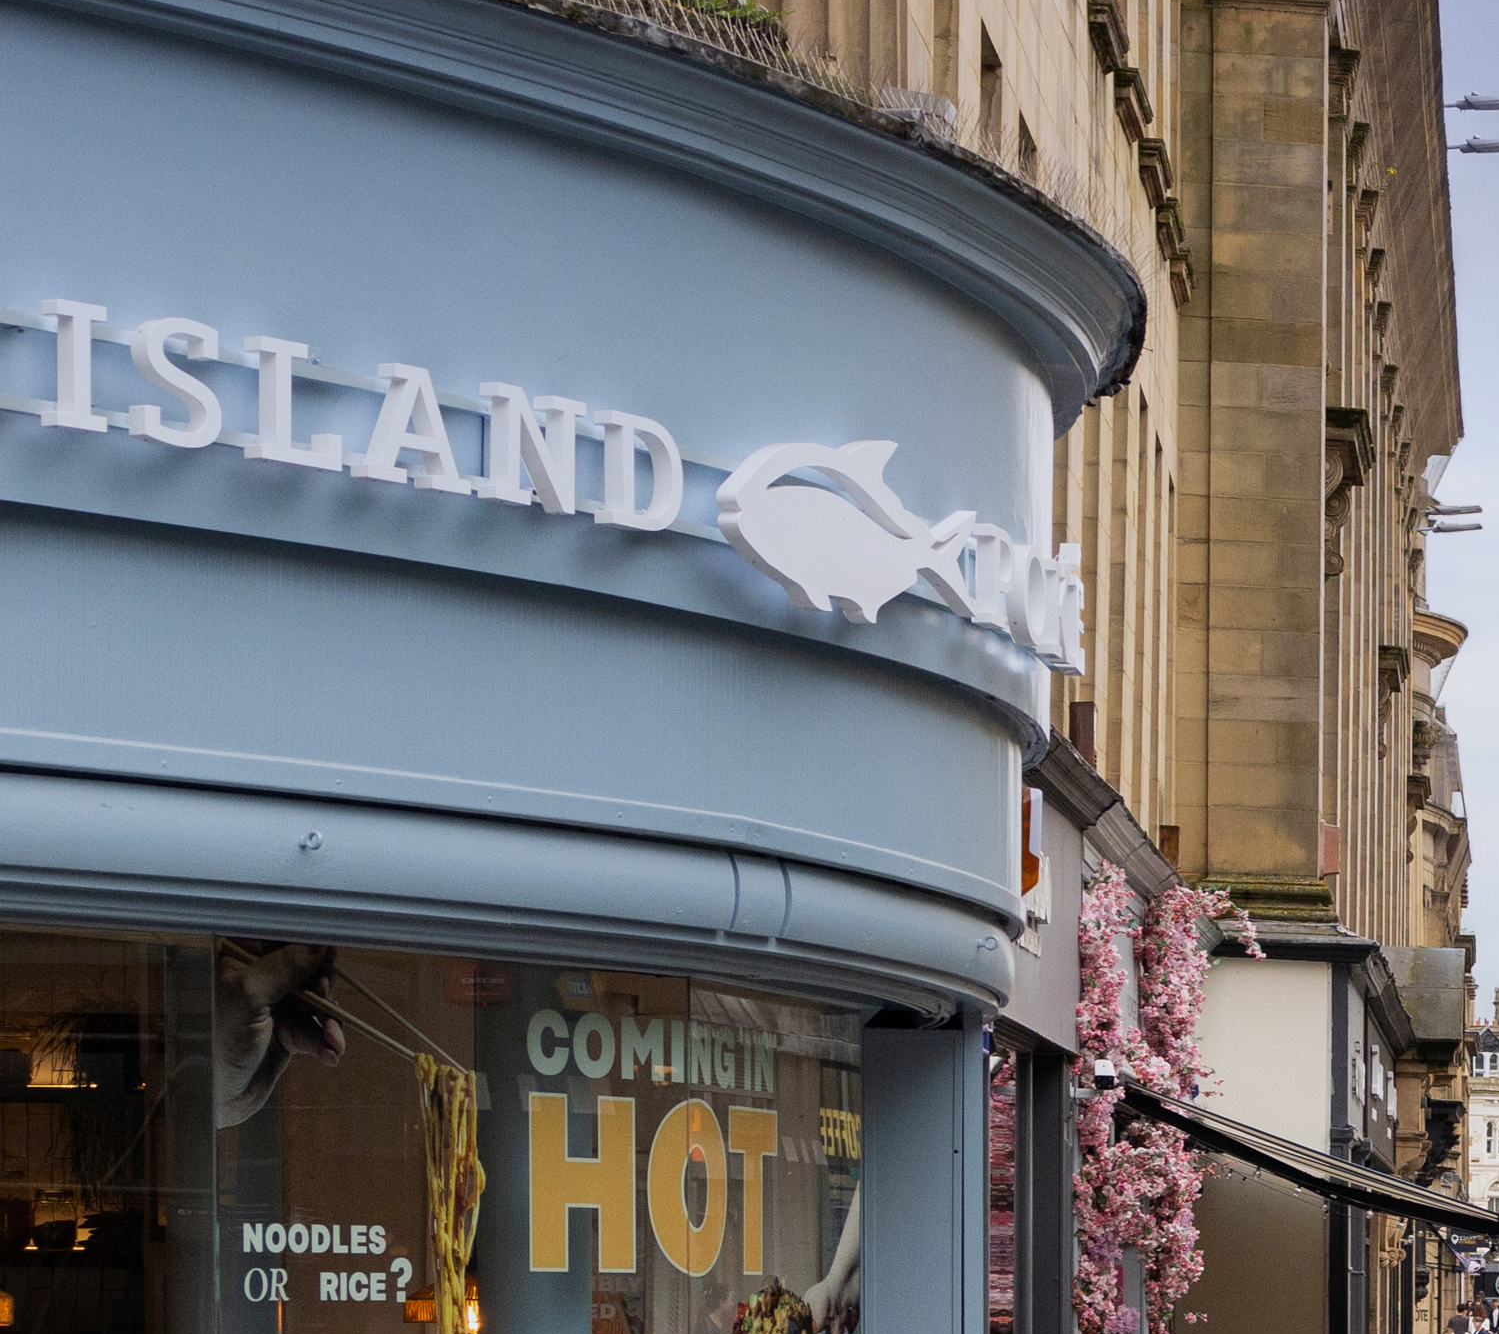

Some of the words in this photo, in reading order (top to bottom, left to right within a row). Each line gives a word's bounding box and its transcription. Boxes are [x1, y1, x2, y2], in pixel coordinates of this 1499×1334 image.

[40, 297, 684, 532] ISLAND
[526, 1008, 736, 1091] COMING
[742, 1029, 775, 1093] IN
[528, 1090, 779, 1278] HOT
[242, 1222, 387, 1255] NOODLES
[243, 1267, 290, 1303] OR
[319, 1257, 413, 1303] RICE?
